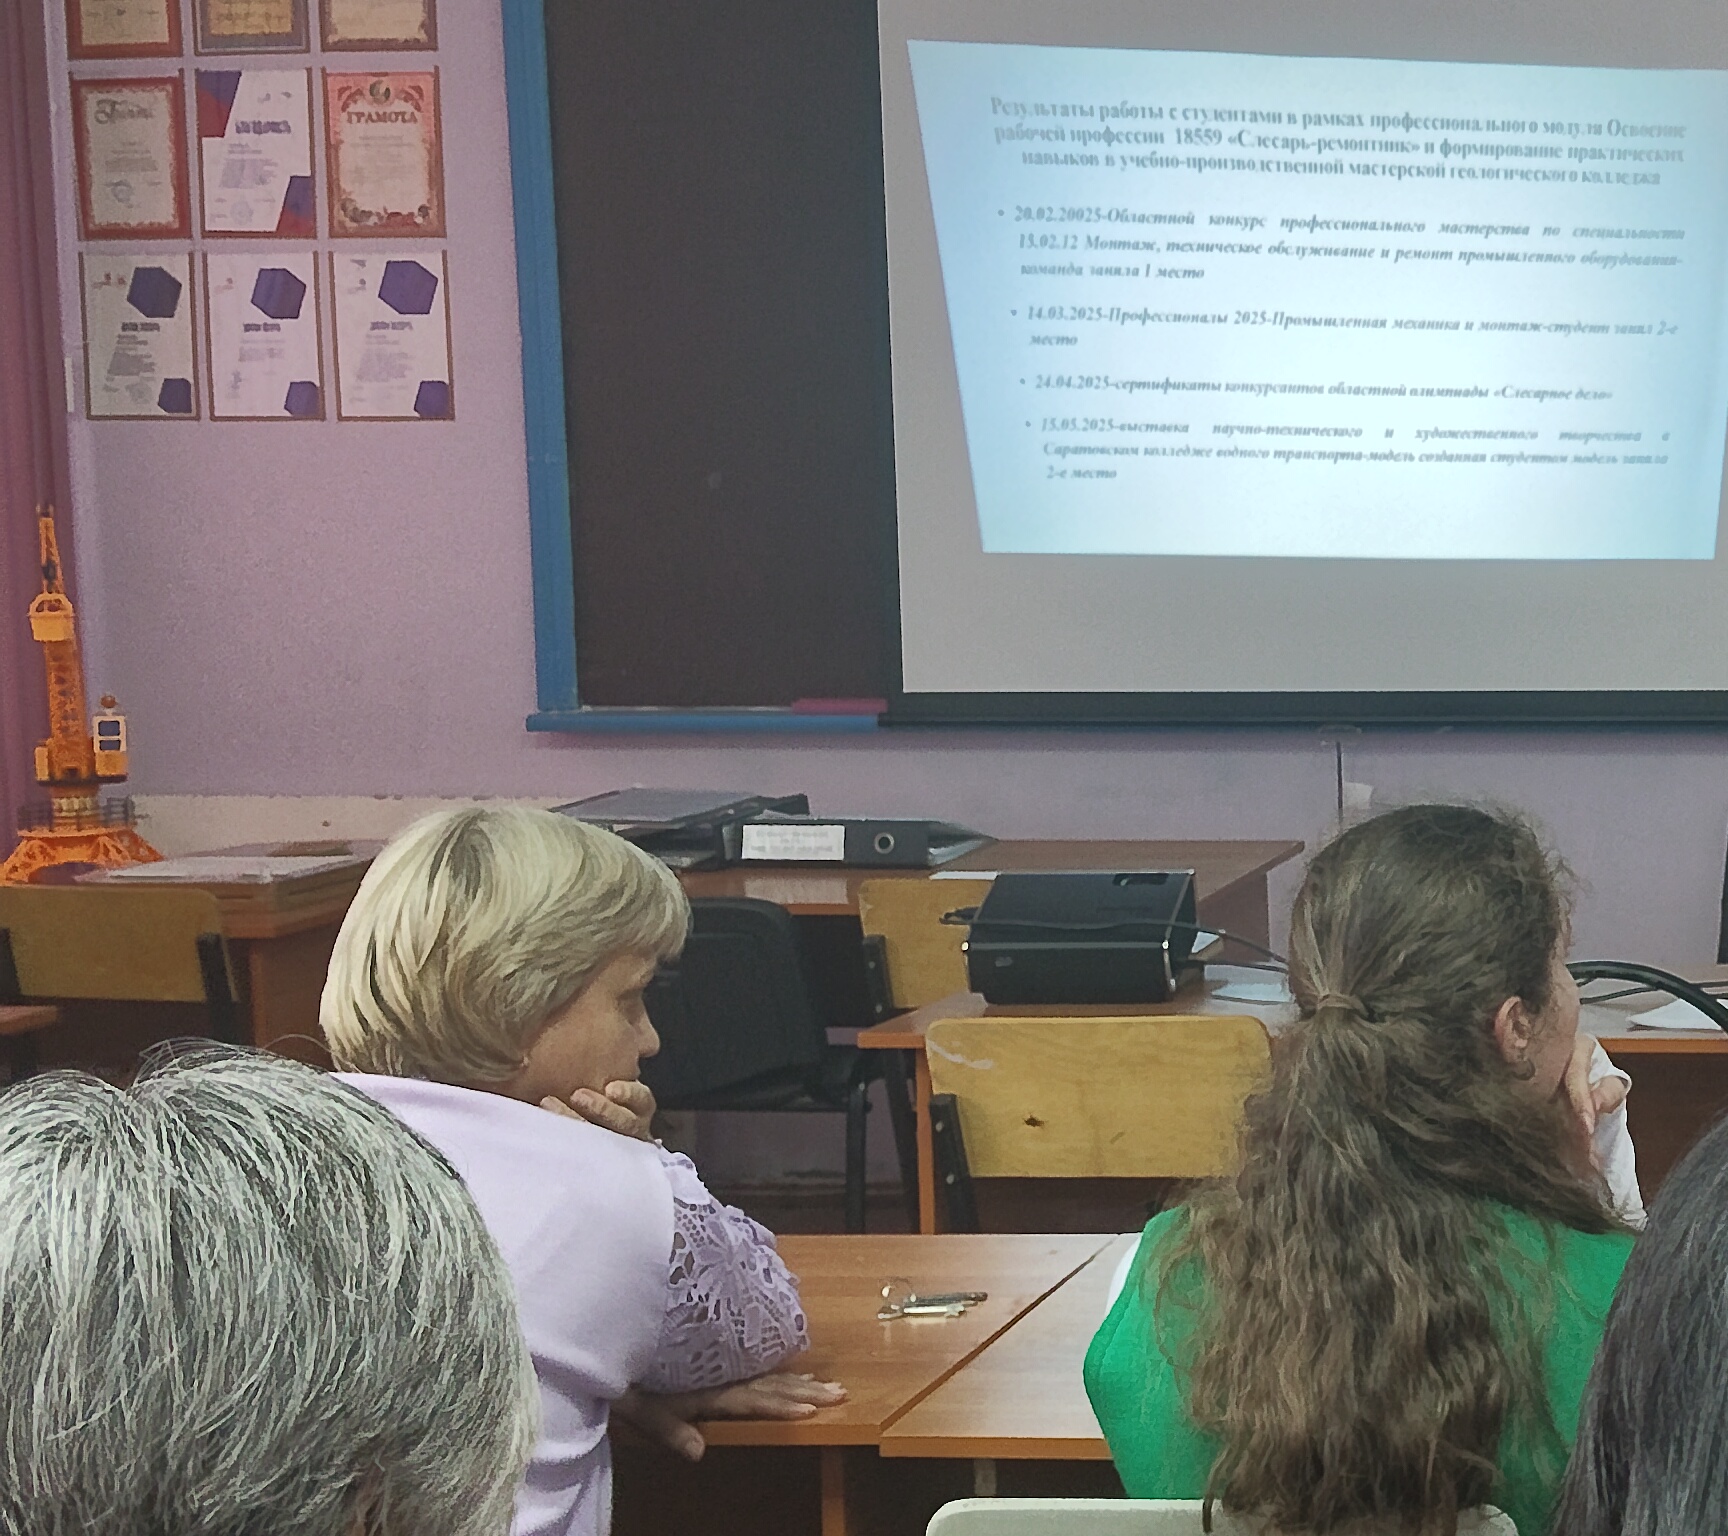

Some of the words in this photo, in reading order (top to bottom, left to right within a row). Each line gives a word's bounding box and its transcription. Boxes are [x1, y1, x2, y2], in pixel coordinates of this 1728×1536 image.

[346, 111, 418, 125] ГРАМОТА
[991, 97, 1094, 117] Результаты
[1099, 101, 1163, 122] работы
[1169, 107, 1177, 120] с
[1182, 107, 1282, 125] студентами
[1287, 110, 1297, 124] в
[1302, 111, 1364, 130] рамках
[1370, 112, 1538, 133] профессионального
[994, 123, 1065, 144] рабочей
[1070, 126, 1164, 146] профессии
[1176, 127, 1222, 145] 18559
[1425, 141, 1434, 155] и
[1439, 138, 1563, 159] формирование
[1568, 147, 1684, 163] практических
[1022, 151, 1099, 166] навыков
[1105, 154, 1114, 167] в
[1349, 162, 1445, 180] мастерской
[1450, 167, 1577, 182] геологического
[1208, 216, 1267, 231] конкурс
[1280, 214, 1426, 233] профессионального
[1438, 223, 1530, 239] мастерства
[1542, 225, 1561, 237] по
[1166, 240, 1262, 255] техническое
[1268, 240, 1375, 259] обслуживание
[1394, 248, 1453, 263] ремонт
[1020, 261, 1084, 278] команда
[1154, 267, 1205, 280] место
[1391, 318, 1460, 331] механика
[1029, 333, 1078, 347] место
[1328, 381, 1406, 398] областной
[1070, 467, 1117, 480] место
